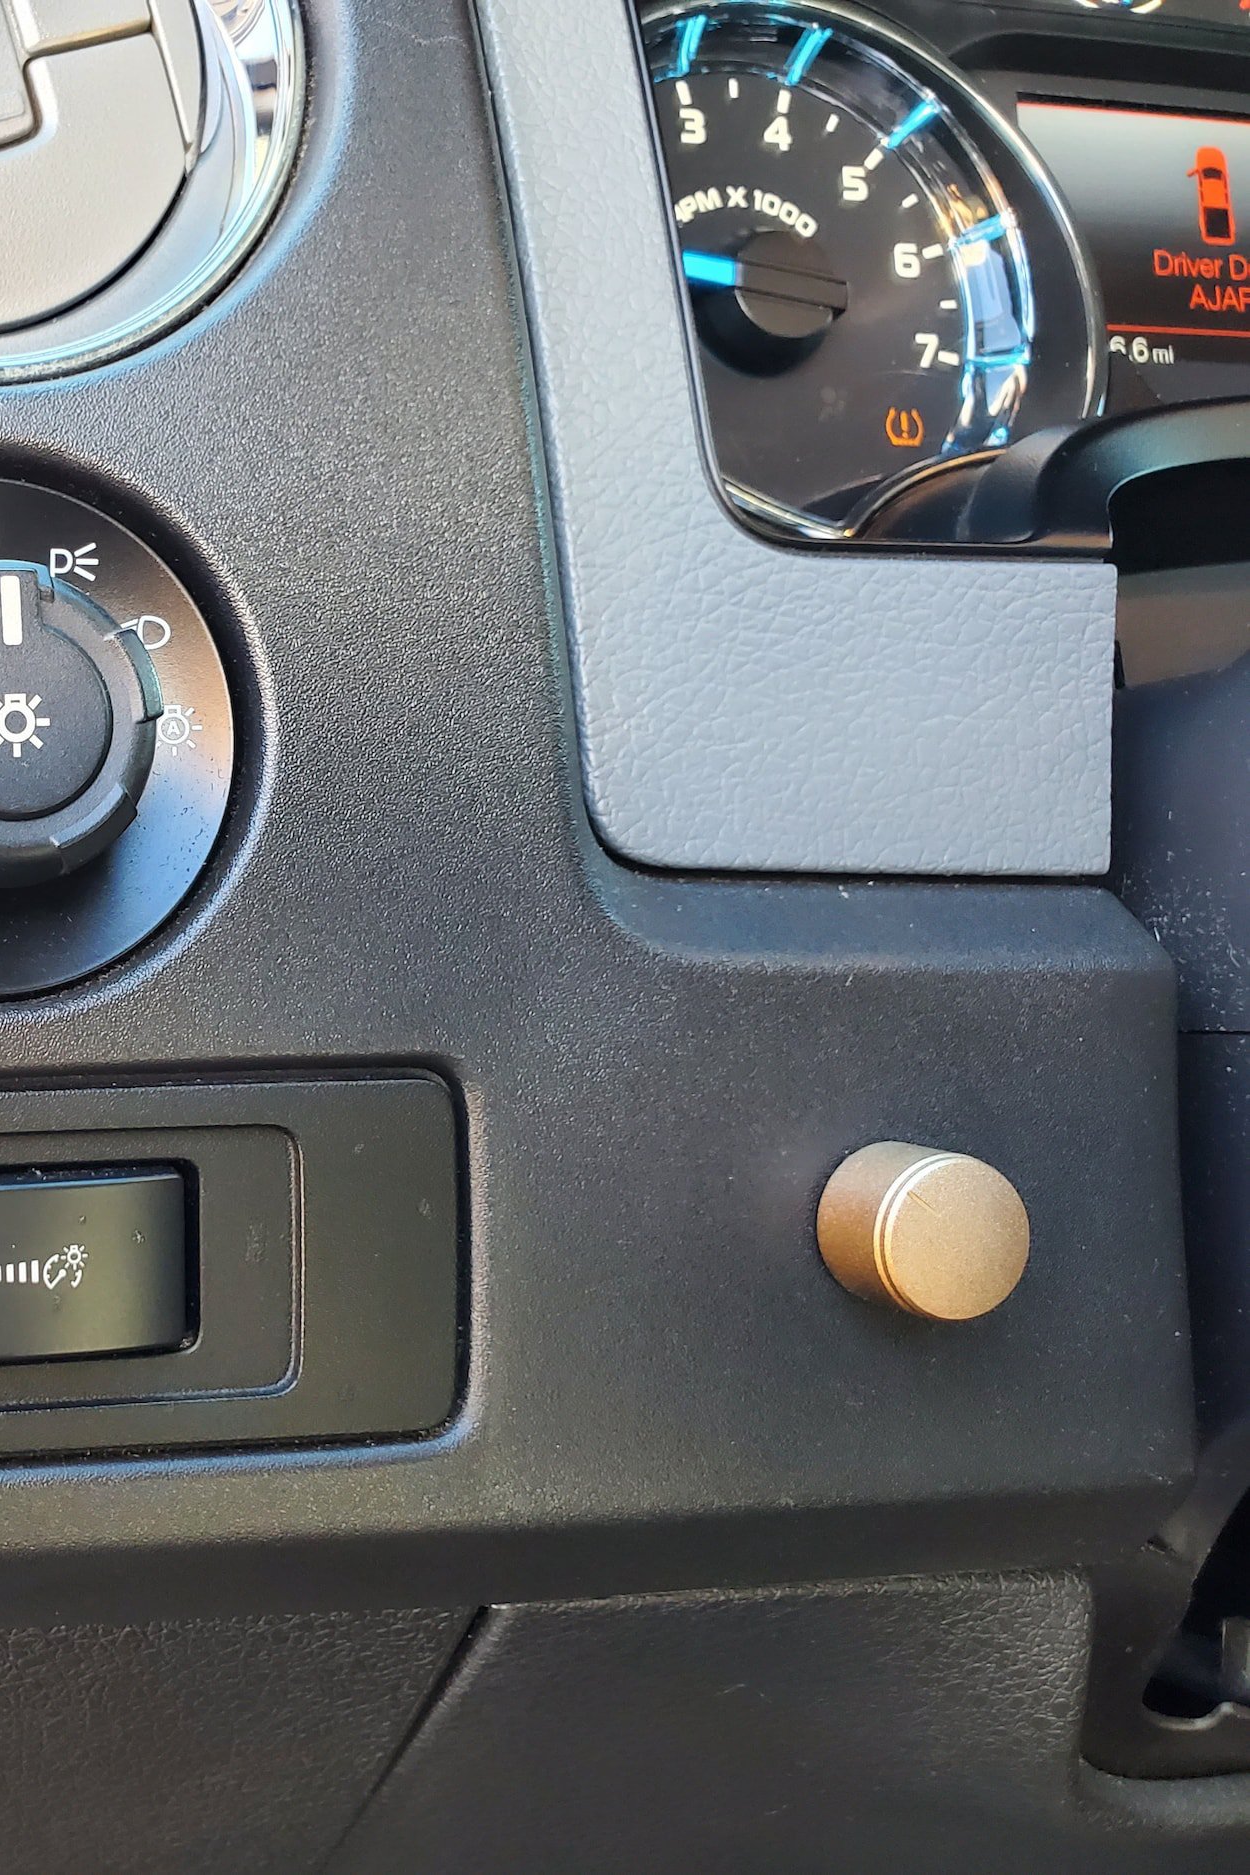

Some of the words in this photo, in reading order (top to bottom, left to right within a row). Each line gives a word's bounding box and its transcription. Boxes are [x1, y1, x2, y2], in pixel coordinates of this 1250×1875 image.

[679, 107, 707, 145] 3
[763, 116, 793, 151] 4
[841, 165, 869, 202] 5
[725, 185, 749, 209] X
[753, 188, 818, 238] 1000
[893, 242, 921, 279] 6
[1153, 249, 1223, 279] Driver
[914, 332, 939, 369] 7
